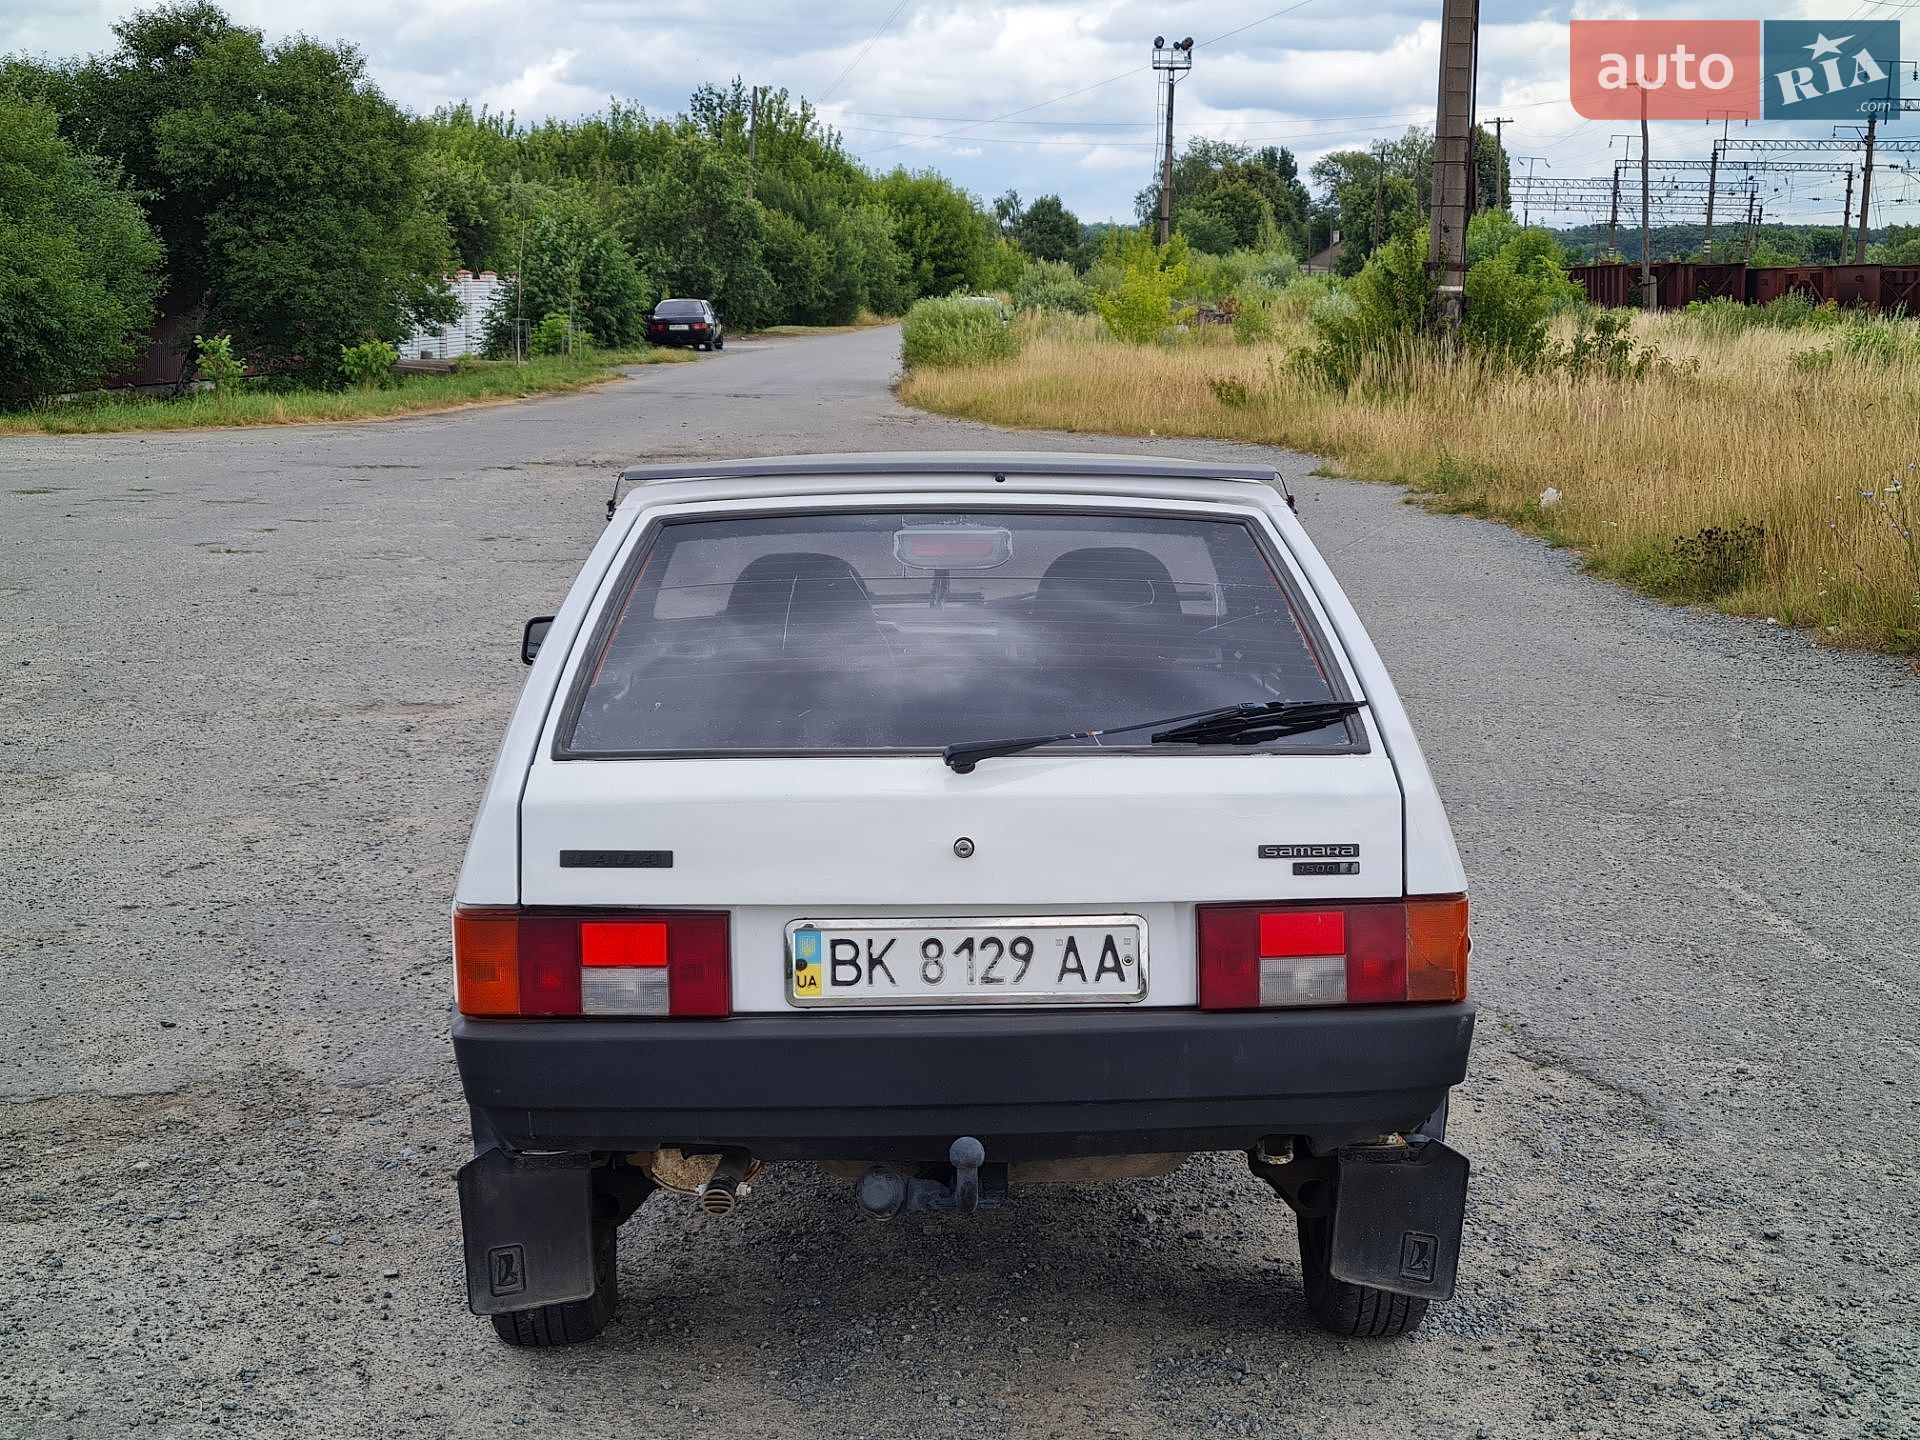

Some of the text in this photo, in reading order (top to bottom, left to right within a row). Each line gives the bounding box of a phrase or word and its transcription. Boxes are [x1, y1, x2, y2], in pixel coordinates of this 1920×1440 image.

[829, 934, 1126, 986] BK 8129 AA
[797, 975, 816, 988] UA
